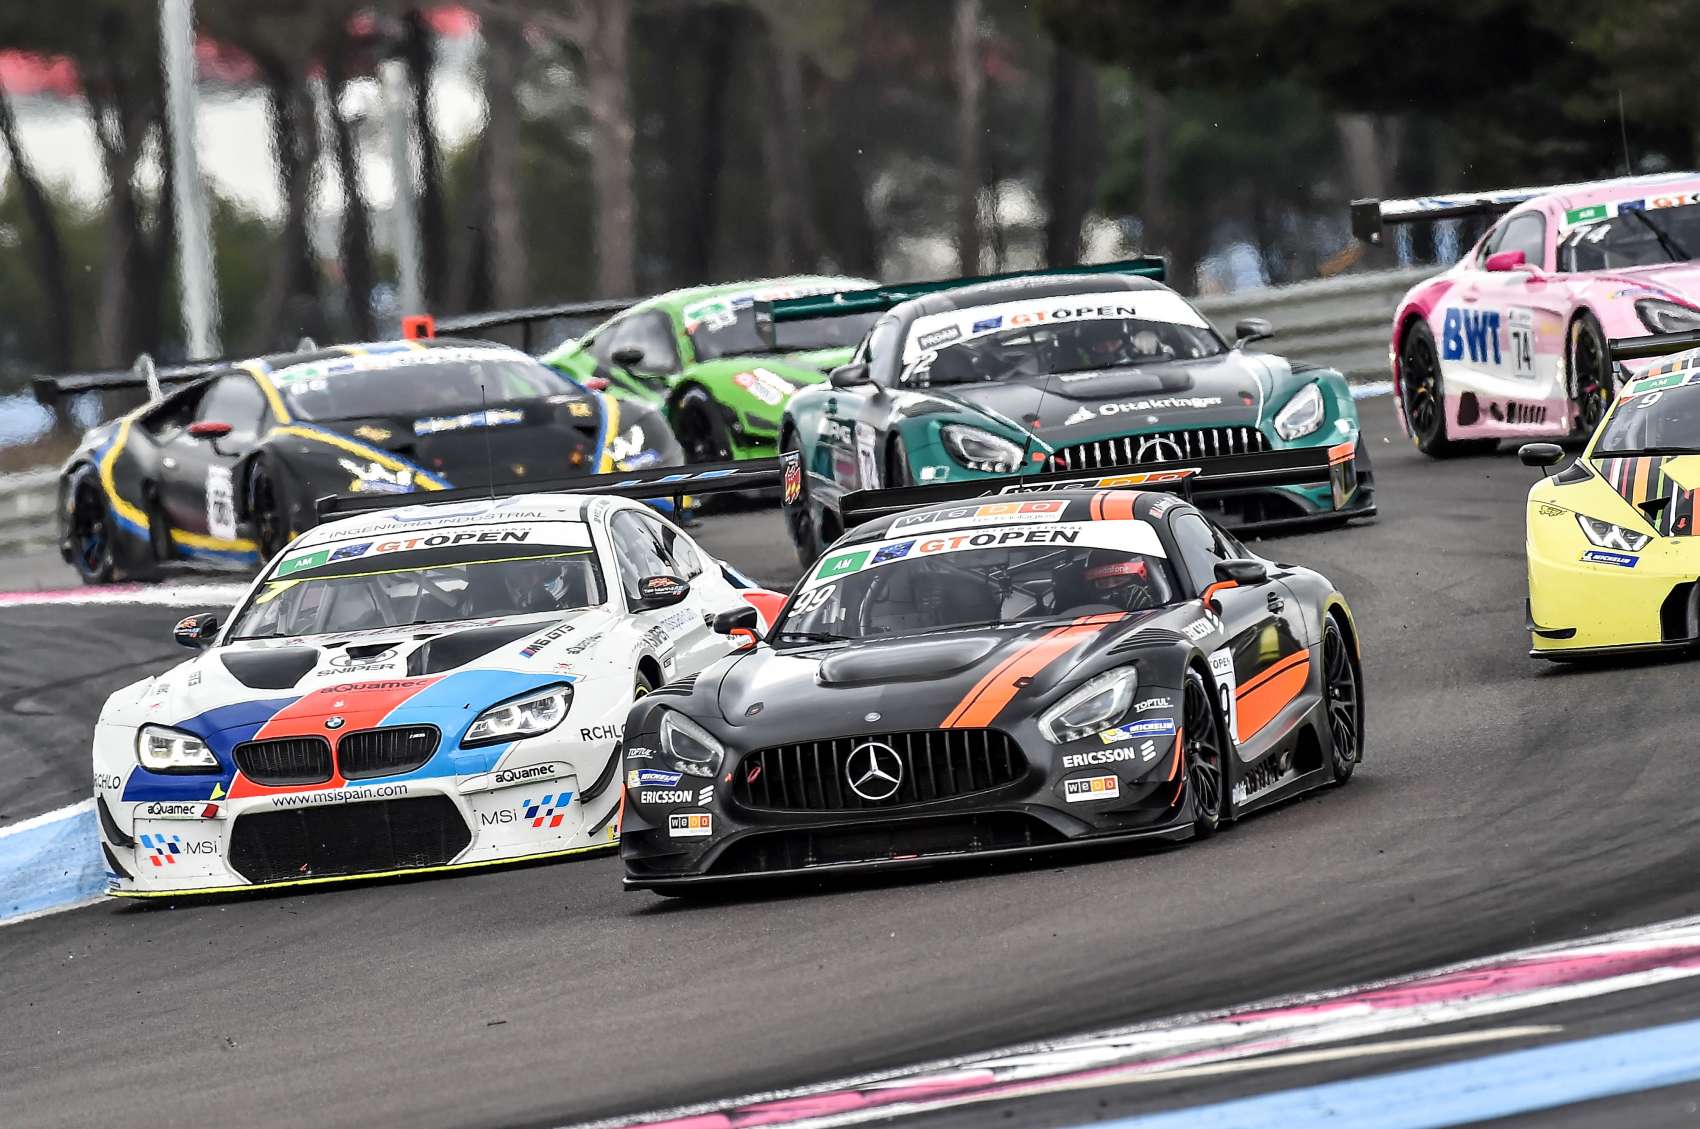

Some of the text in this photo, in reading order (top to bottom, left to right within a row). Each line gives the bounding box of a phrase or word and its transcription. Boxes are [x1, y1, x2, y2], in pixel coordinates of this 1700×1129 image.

[1570, 224, 1611, 246] 74
[1443, 307, 1502, 365] BWT
[1512, 331, 1532, 371] 74
[900, 351, 938, 382] 72
[1650, 379, 1668, 388] AM
[1099, 397, 1223, 416] Ottakringer
[1636, 392, 1664, 409] 9
[329, 511, 547, 539] INGENIERIA INDUSTRIAL
[976, 525, 1083, 534] INTERNATIONAL
[294, 557, 313, 569] AM
[832, 558, 853, 571] AM
[787, 584, 837, 618] 99
[317, 663, 396, 677] SNIPER
[320, 679, 427, 695] aQuamec
[1133, 698, 1170, 712] TOPTUL
[1062, 746, 1136, 768] ERICSSON
[495, 763, 555, 783] aQuamec
[271, 784, 408, 808] www.msispain.com
[640, 790, 693, 804] ERICSSON
[147, 802, 196, 815] aQuamec
[481, 808, 518, 826] MSi
[186, 840, 218, 855] MSi
